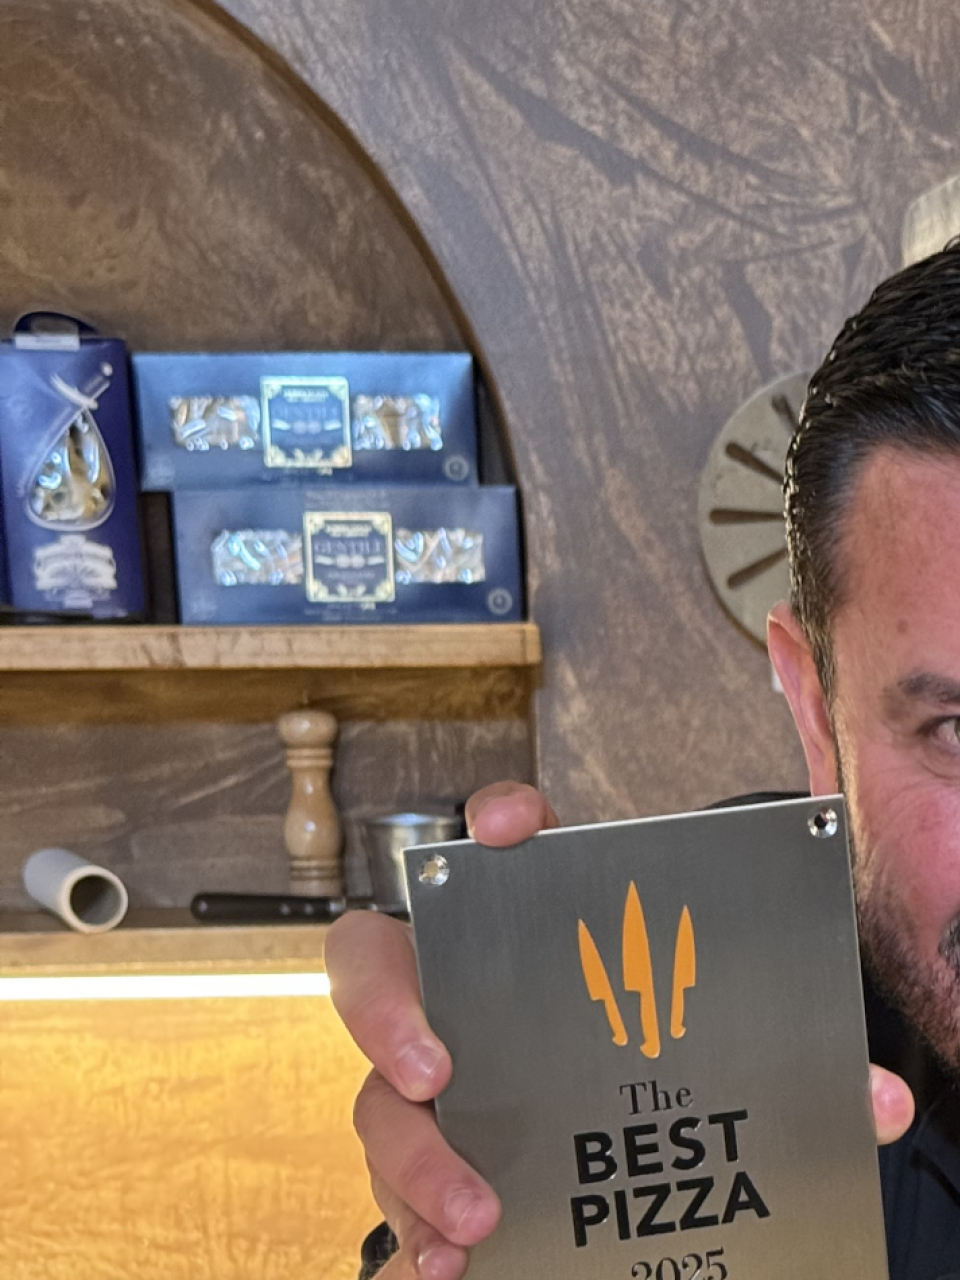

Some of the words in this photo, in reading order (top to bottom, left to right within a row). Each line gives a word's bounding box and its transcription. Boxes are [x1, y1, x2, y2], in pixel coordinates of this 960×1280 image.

[619, 1079, 693, 1115] The
[573, 1109, 748, 1184] BEST
[570, 1171, 771, 1248] PIZZA
